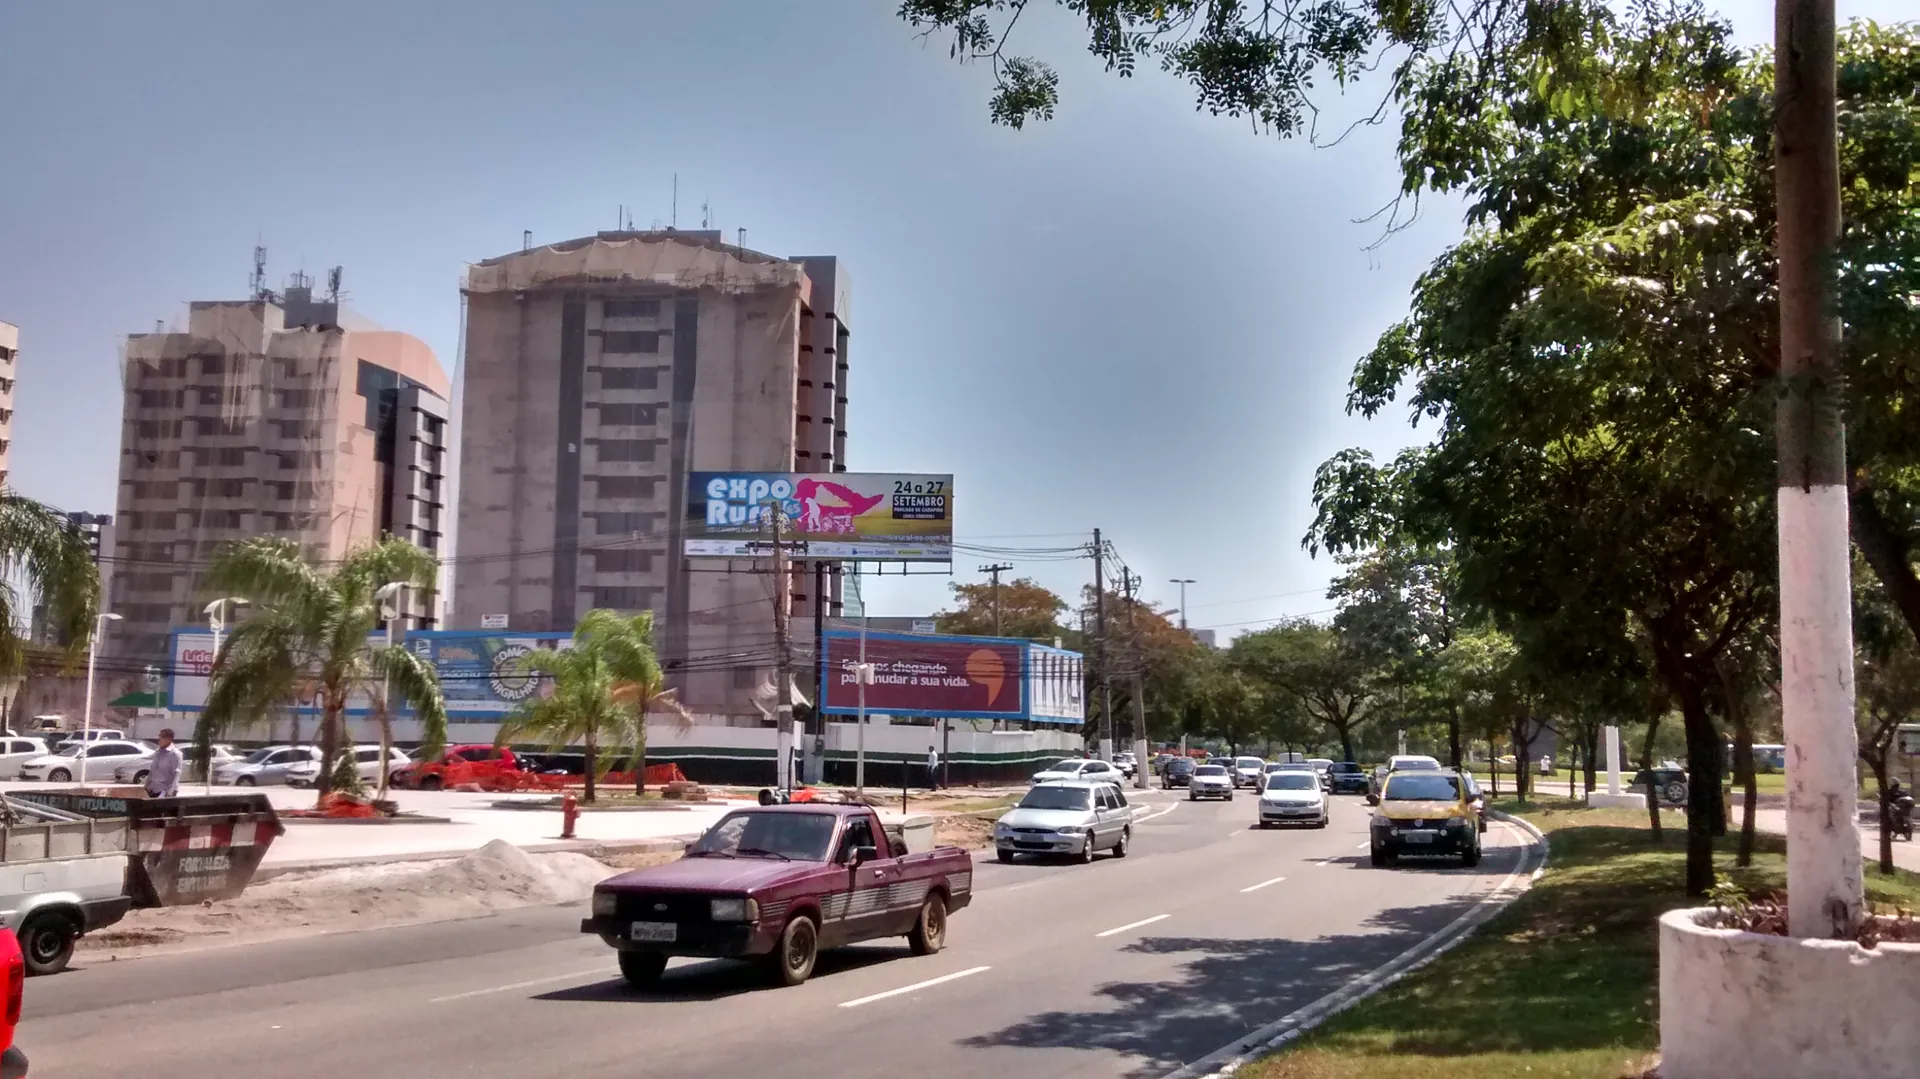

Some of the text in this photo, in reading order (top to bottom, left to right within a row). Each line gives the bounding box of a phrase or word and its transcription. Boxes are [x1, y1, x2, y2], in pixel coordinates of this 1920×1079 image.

[706, 478, 791, 504] expo
[894, 481, 944, 494] 24 a 27
[894, 496, 944, 507] SETEMBRO
[842, 659, 947, 675] Estos chegando
[911, 677, 917, 685] a
[920, 677, 940, 686] sua
[942, 677, 970, 687] vida.
[179, 855, 231, 873] FORTALEZA
